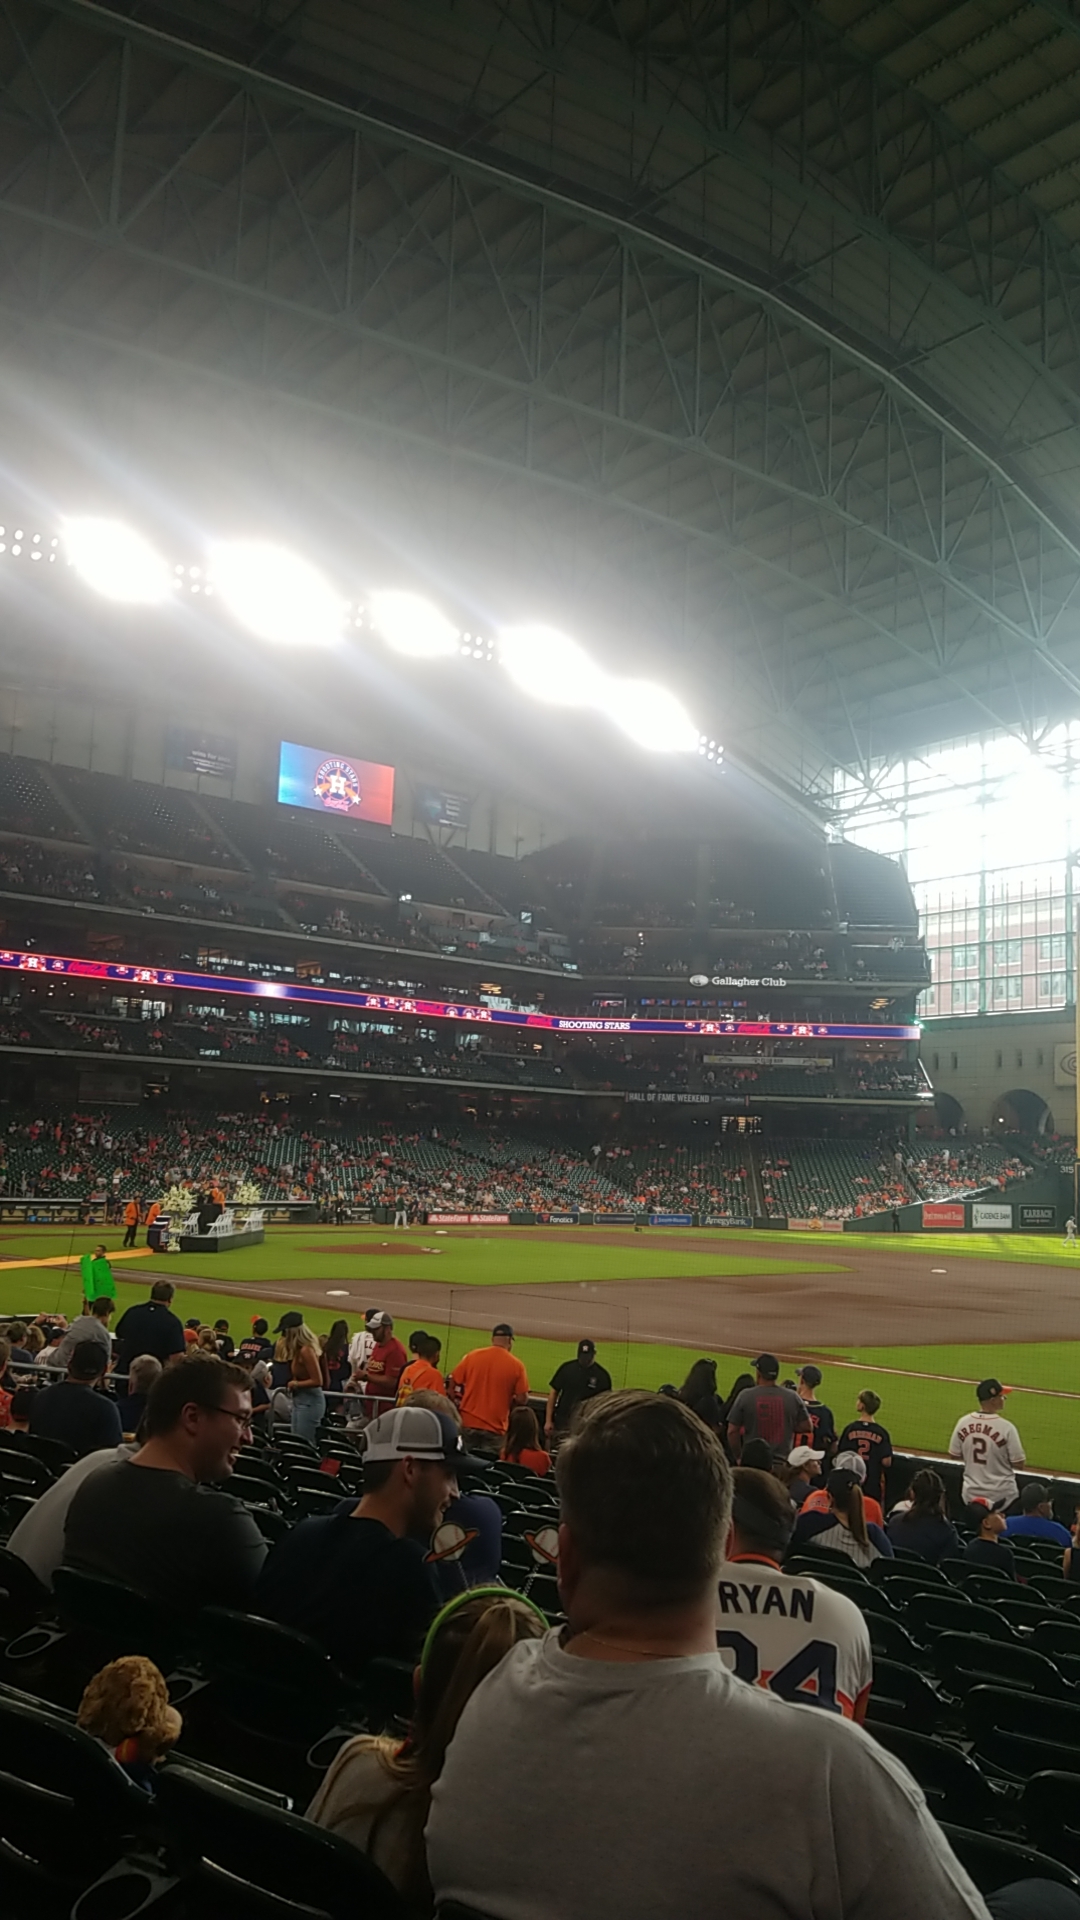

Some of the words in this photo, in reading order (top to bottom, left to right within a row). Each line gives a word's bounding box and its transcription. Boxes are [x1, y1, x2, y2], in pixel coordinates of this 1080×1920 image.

[711, 976, 760, 987] Gallagher
[761, 977, 787, 987] Club
[559, 1020, 603, 1029] SHOOTING
[604, 1021, 630, 1030] STARS
[629, 1092, 645, 1101] HALL
[646, 1093, 655, 1101] OF
[657, 1093, 675, 1102] FAME
[677, 1094, 710, 1103] WEEKEND
[1059, 1165, 1074, 1174] 315
[549, 1215, 574, 1223] Fanatics
[1023, 1209, 1053, 1219] KARBACH
[957, 1423, 1007, 1448] BREGMAN
[972, 1436, 987, 1465] 2
[718, 1580, 814, 1623] RYAN
